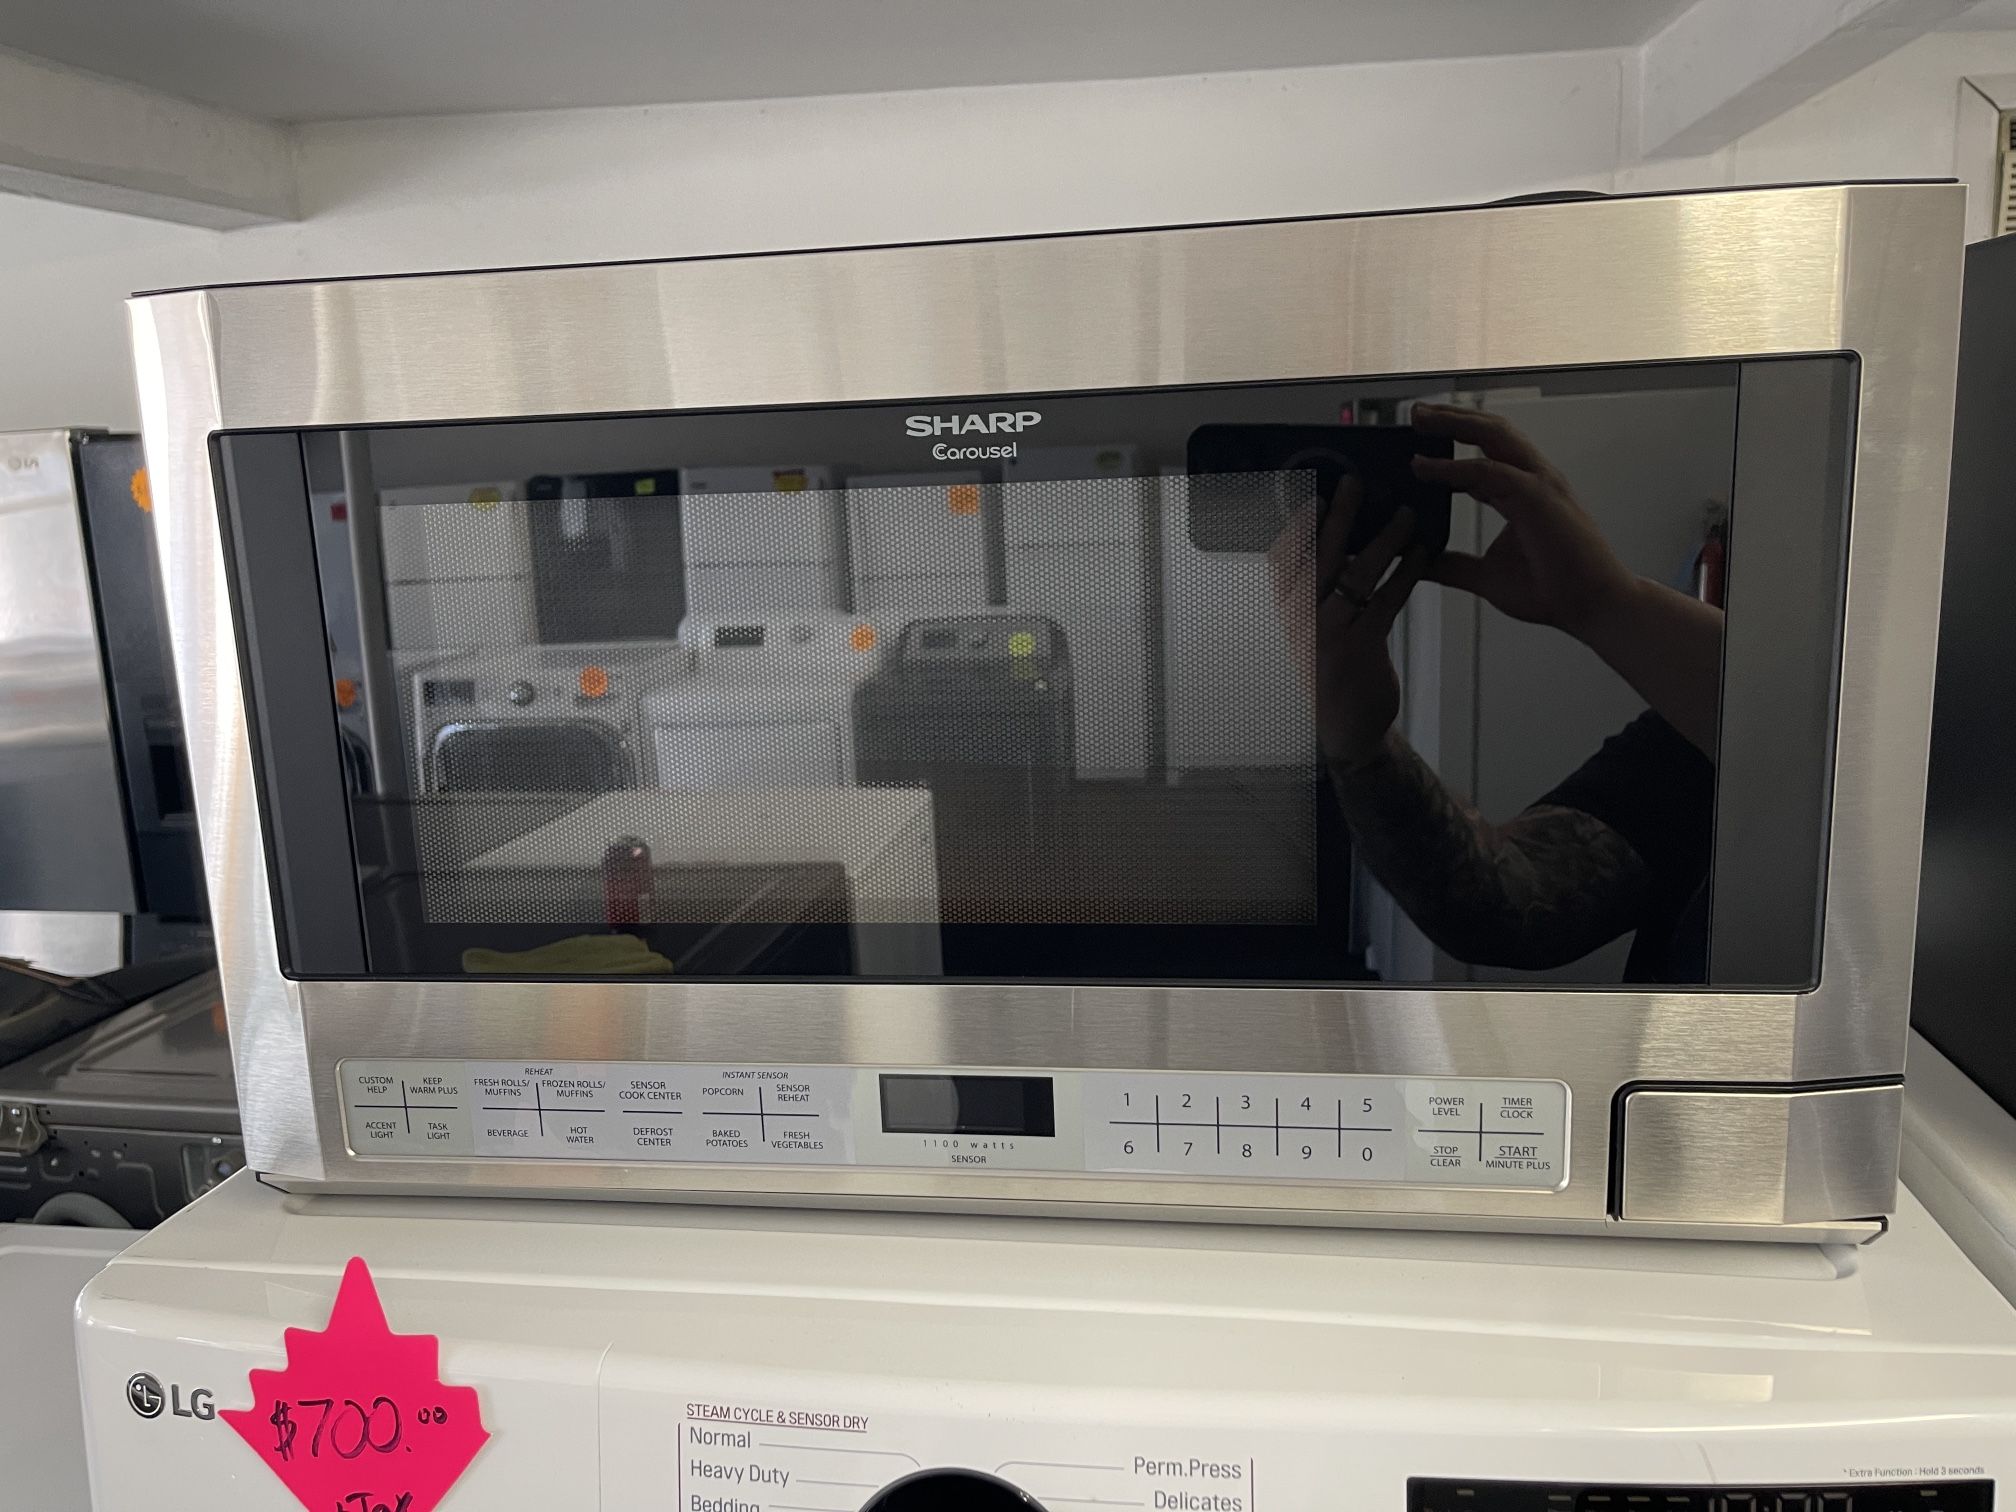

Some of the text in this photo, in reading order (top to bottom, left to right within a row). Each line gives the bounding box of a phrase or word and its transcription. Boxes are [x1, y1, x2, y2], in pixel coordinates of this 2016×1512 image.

[905, 410, 1042, 438] SHARP
[932, 441, 1018, 461] Carousel
[524, 1067, 554, 1076] REHEAT
[721, 1071, 789, 1080] INSTANT SENSOR
[358, 1076, 394, 1085] CUSTOM
[422, 1077, 443, 1086] KEEP
[473, 1078, 531, 1088] FRESH ROLLS/
[542, 1080, 606, 1089] FROZEN ROLLS/
[630, 1080, 667, 1090] SENSOR
[366, 1085, 388, 1095] HELP
[409, 1086, 459, 1096] WARM PLUS
[484, 1088, 522, 1097] MUFFINS
[702, 1087, 745, 1097] POPCORN
[775, 1083, 811, 1093] SENSOR
[556, 1089, 594, 1098] MUFFINS
[618, 1090, 683, 1101] COOK CENTER
[777, 1093, 810, 1102] REHEAT
[1123, 1092, 1373, 1113] 1 2 3 4 5
[1428, 1096, 1465, 1107] POWER
[1502, 1097, 1533, 1107] TIMER
[1432, 1107, 1461, 1117] LEVEL
[1499, 1109, 1534, 1119] CLOCK
[365, 1121, 397, 1130] ACCENT
[427, 1122, 449, 1131] TASK
[570, 1126, 588, 1135] HOT
[370, 1130, 394, 1139] LIGHT
[426, 1131, 451, 1141] LIGHT
[487, 1128, 529, 1138] BEVERAGE
[632, 1127, 674, 1137] DEFROST
[712, 1129, 741, 1139] BAKED
[783, 1130, 810, 1140] FRESH
[566, 1135, 595, 1144] WATER
[636, 1137, 672, 1147] CENTER
[705, 1138, 749, 1148] POTATOES
[922, 1139, 1015, 1150] 1100 watts
[771, 1140, 824, 1150] VEGETABLES
[1433, 1145, 1459, 1155] STOP
[1123, 1140, 1373, 1162] 6 7 8 9 0
[1499, 1145, 1538, 1157] START
[950, 1154, 987, 1164] SENSOR
[1429, 1158, 1461, 1168] CLEAR
[1485, 1160, 1551, 1171] MINUTE PLUS
[171, 1384, 215, 1420] LG
[686, 1402, 869, 1430] STEAM CYCLE & SENSOR DRY
[689, 1426, 751, 1449] Normal
[1133, 1455, 1243, 1480] Perm.Press
[1849, 1468, 1873, 1478] Extra
[1874, 1467, 1913, 1478] Function
[1918, 1466, 1940, 1477] Hold
[1940, 1466, 1947, 1476] 3
[1947, 1466, 1985, 1476] seconds
[690, 1459, 790, 1489] Heavy Duty
[1154, 1490, 1243, 1512] Delicates
